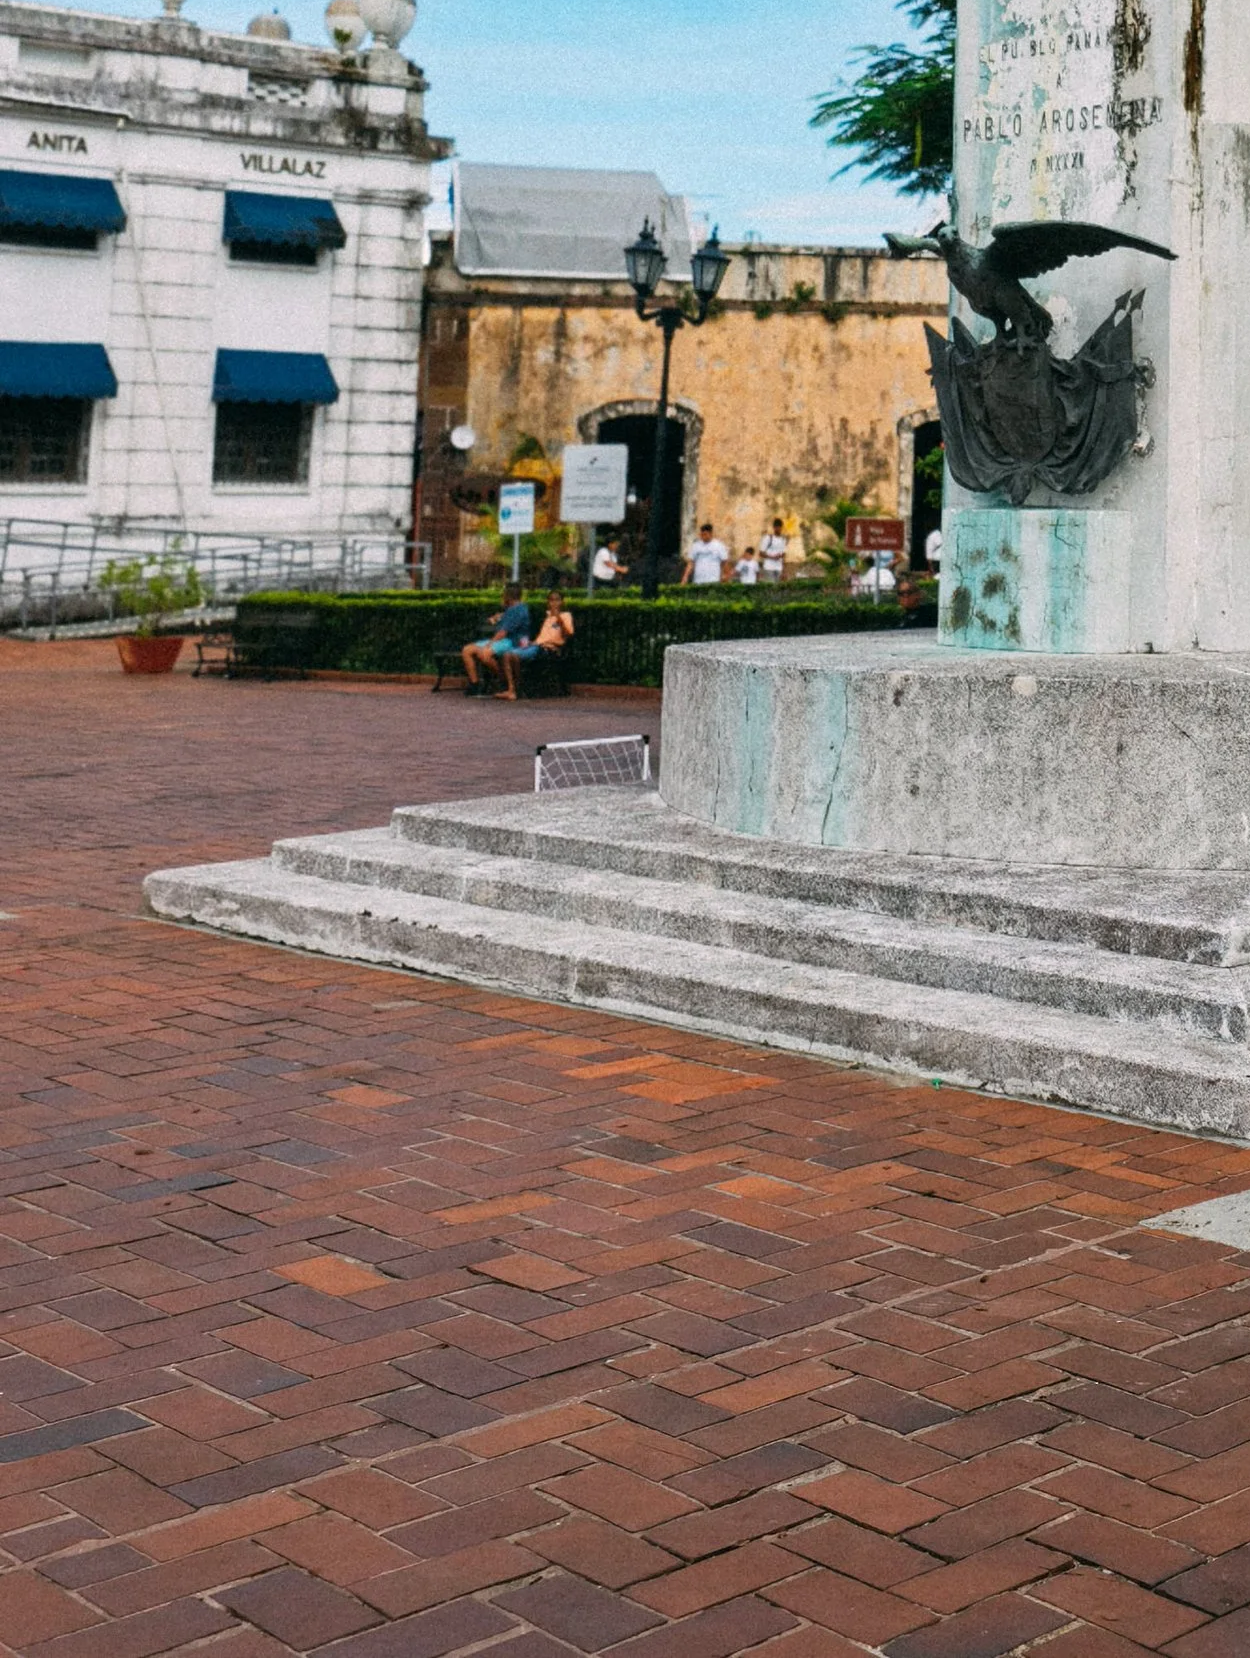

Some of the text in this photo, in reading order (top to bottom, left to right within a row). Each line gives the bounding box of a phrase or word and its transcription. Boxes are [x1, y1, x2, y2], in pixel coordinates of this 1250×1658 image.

[1001, 39, 1056, 61] PUBLO
[963, 113, 1022, 142] PABLO
[27, 131, 326, 179] ANITA VILLALAZ
